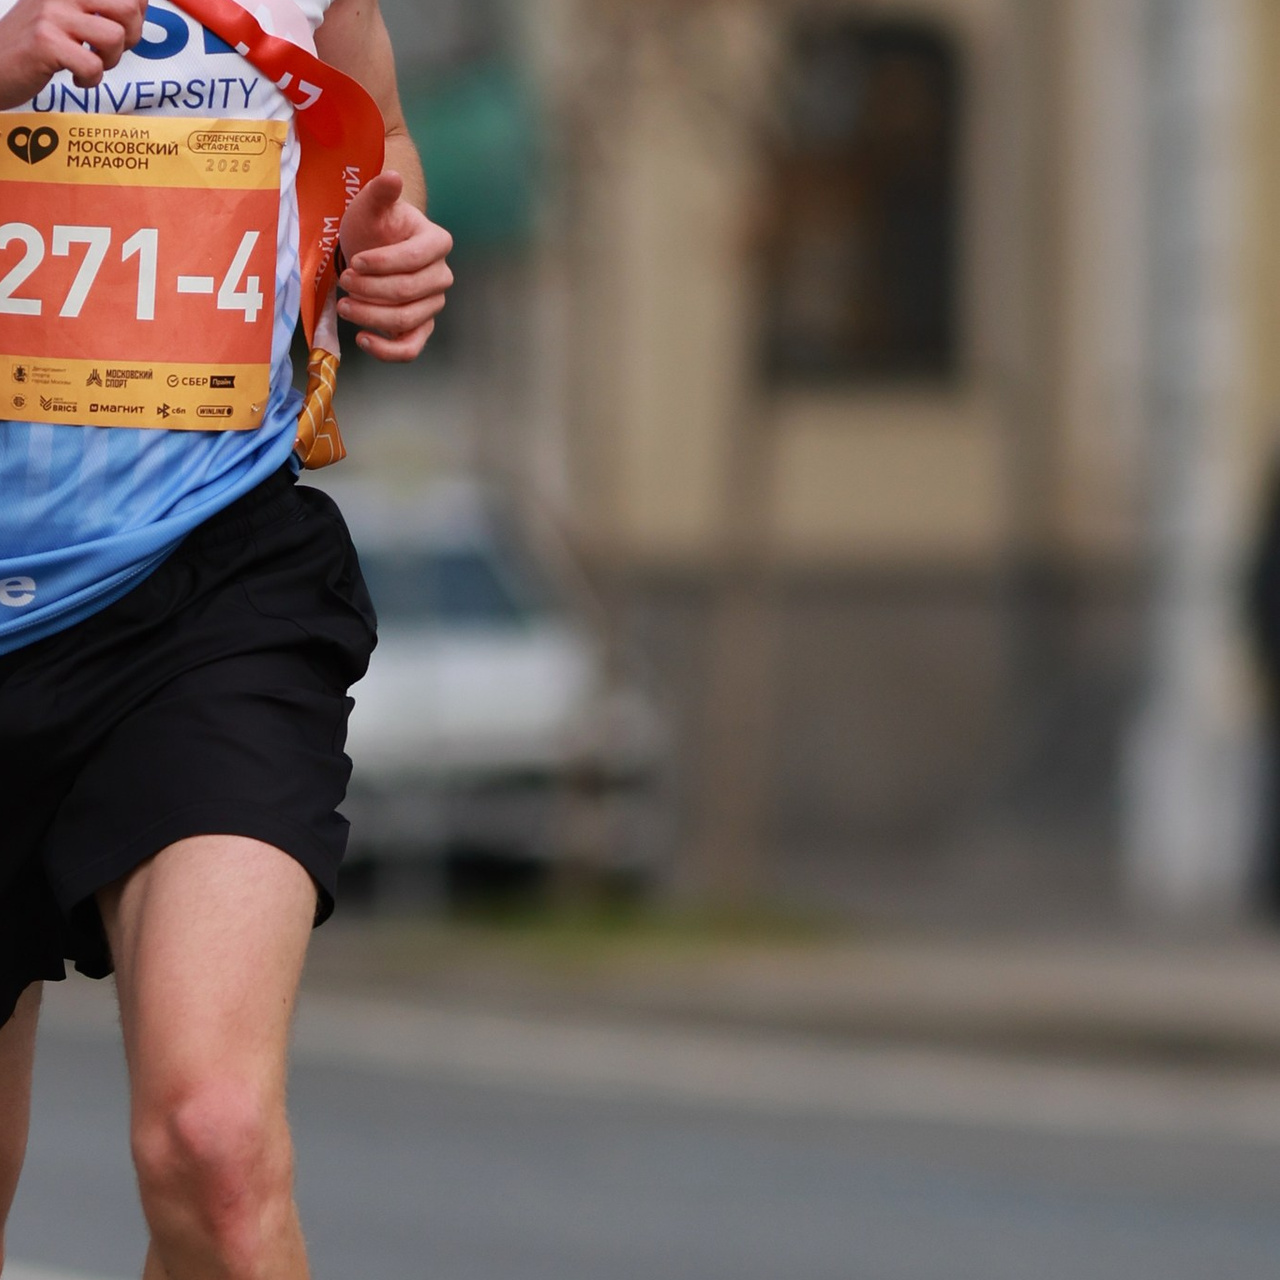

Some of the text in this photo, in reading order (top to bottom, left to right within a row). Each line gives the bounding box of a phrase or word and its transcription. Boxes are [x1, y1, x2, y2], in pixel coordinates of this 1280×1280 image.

[31, 77, 259, 113] UNIVERSITY
[68, 126, 150, 139] СБЕРПРАЙМ
[196, 134, 262, 144] СТУДЕНЧЕСКАЯ
[67, 140, 179, 156] МОСКОВСКИЙ
[195, 142, 240, 152] ЭСТАФЕТА
[66, 155, 149, 170] МАРАФОН
[205, 158, 251, 173] 2026
[105, 368, 153, 380] МОСКОВСКИЙ
[105, 379, 127, 389] СПОРТ
[182, 377, 208, 386] СБЕР
[53, 404, 78, 413] BRICS
